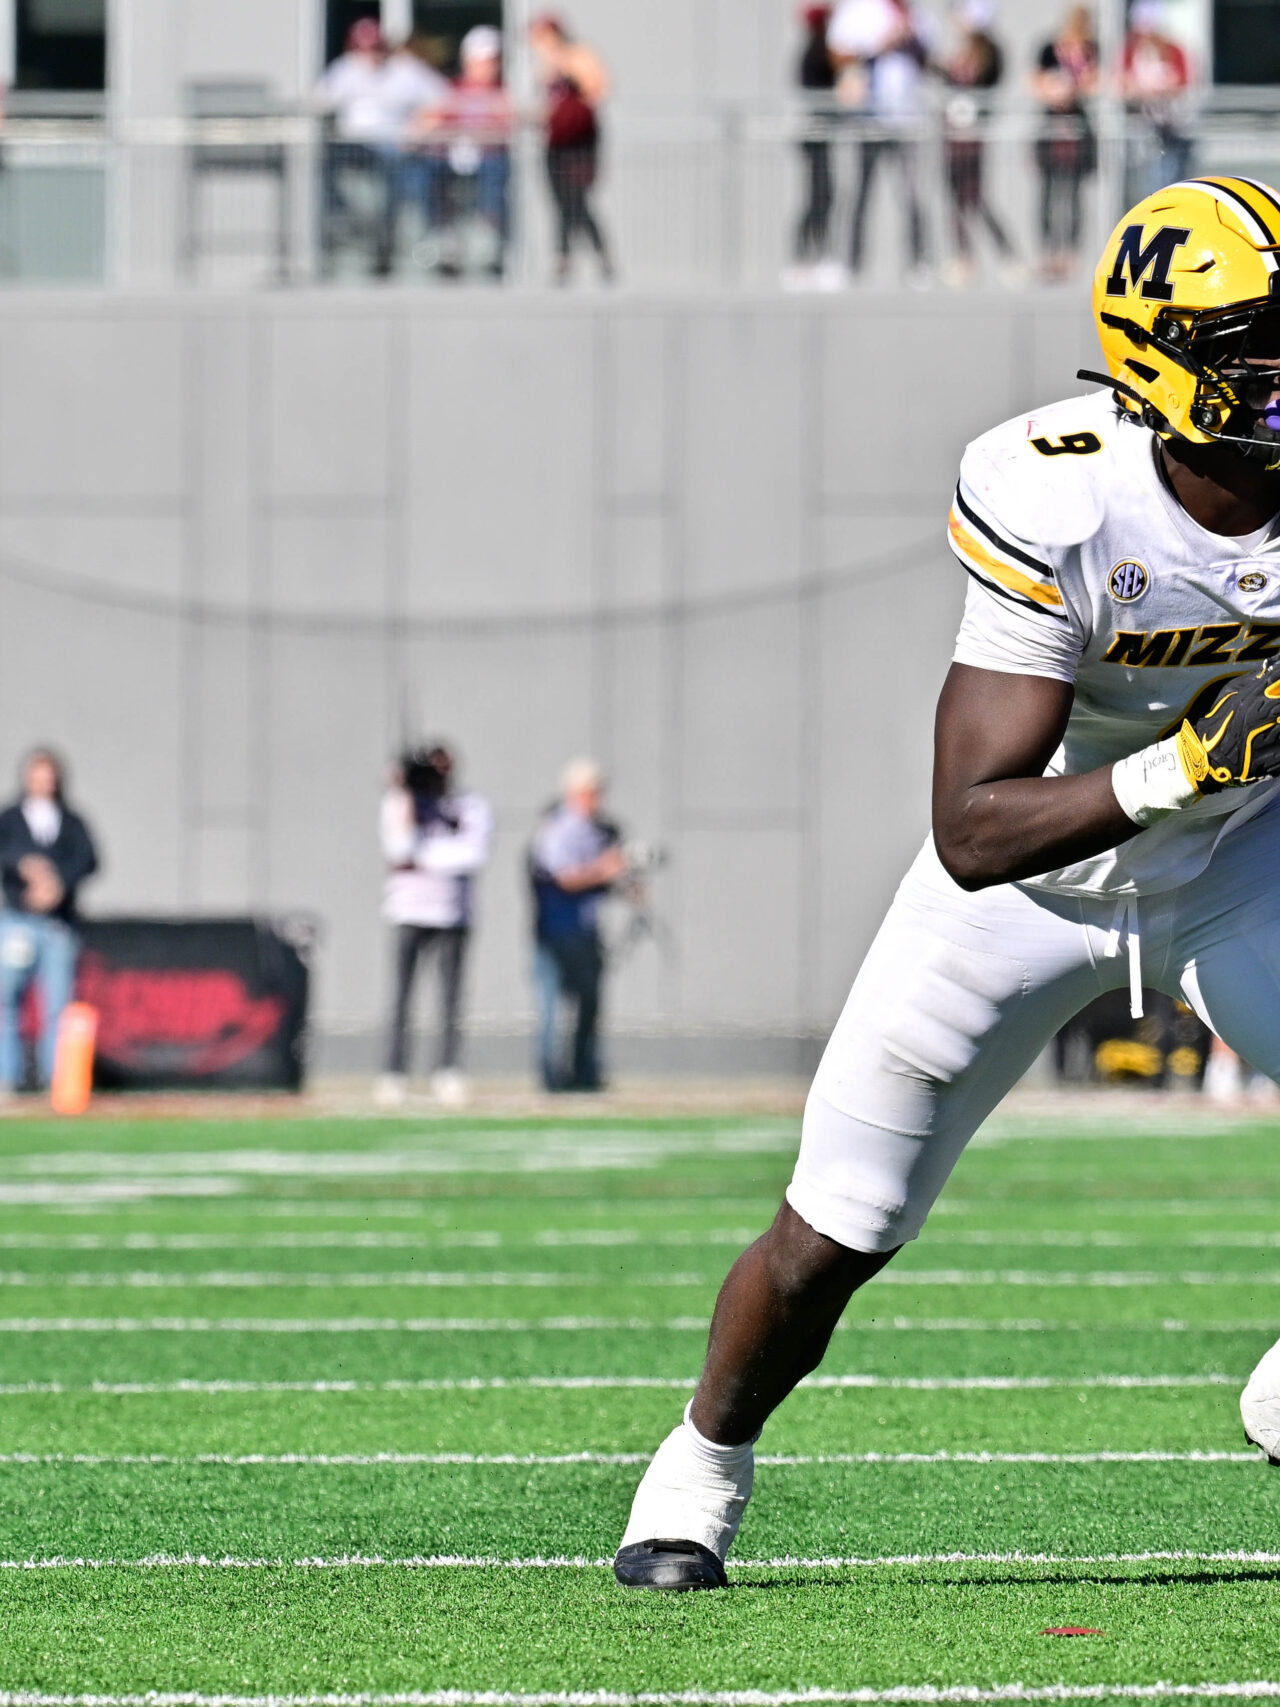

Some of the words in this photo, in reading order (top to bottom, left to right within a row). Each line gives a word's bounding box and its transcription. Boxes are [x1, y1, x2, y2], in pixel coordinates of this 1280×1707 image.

[1106, 224, 1193, 302] M
[1028, 430, 1104, 457] 9
[1112, 563, 1144, 599] SEC
